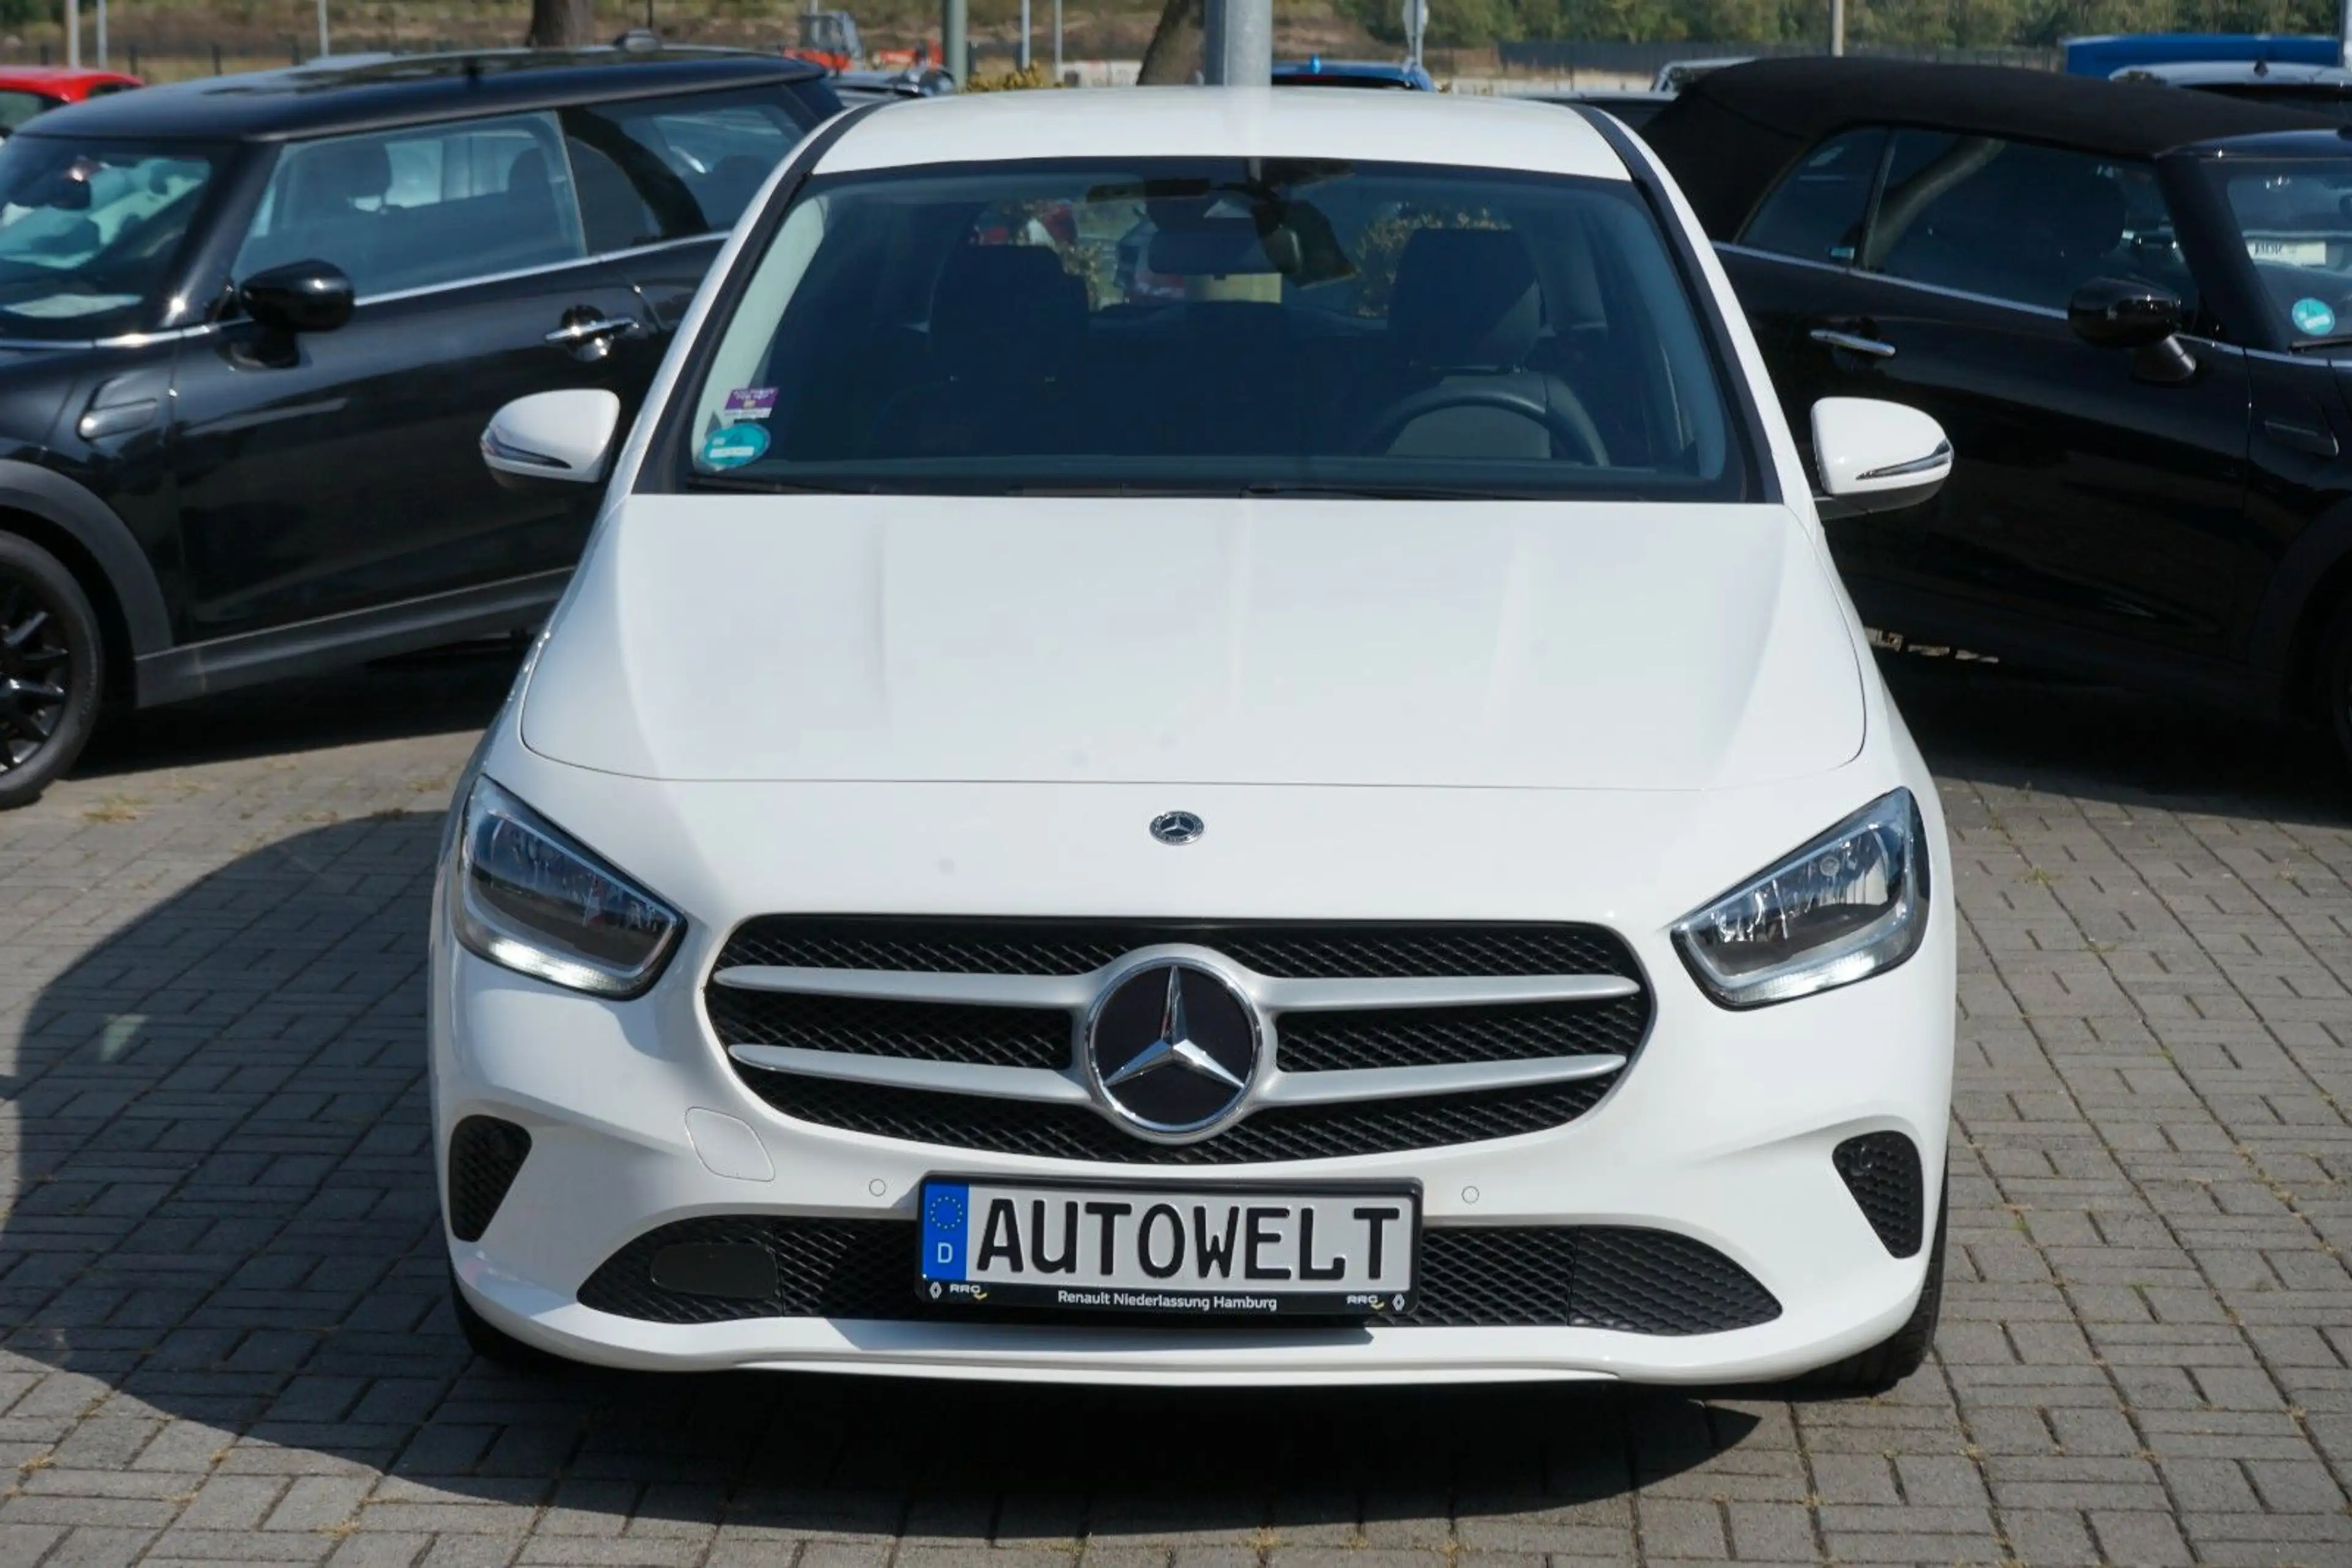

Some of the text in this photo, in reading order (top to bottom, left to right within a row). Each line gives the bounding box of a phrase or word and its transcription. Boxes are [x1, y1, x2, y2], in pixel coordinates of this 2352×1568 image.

[977, 1198, 1400, 1280] AUTOWELT
[938, 1243, 952, 1264] D
[1058, 1289, 1277, 1311] Renault Niederlassung Hamburg
